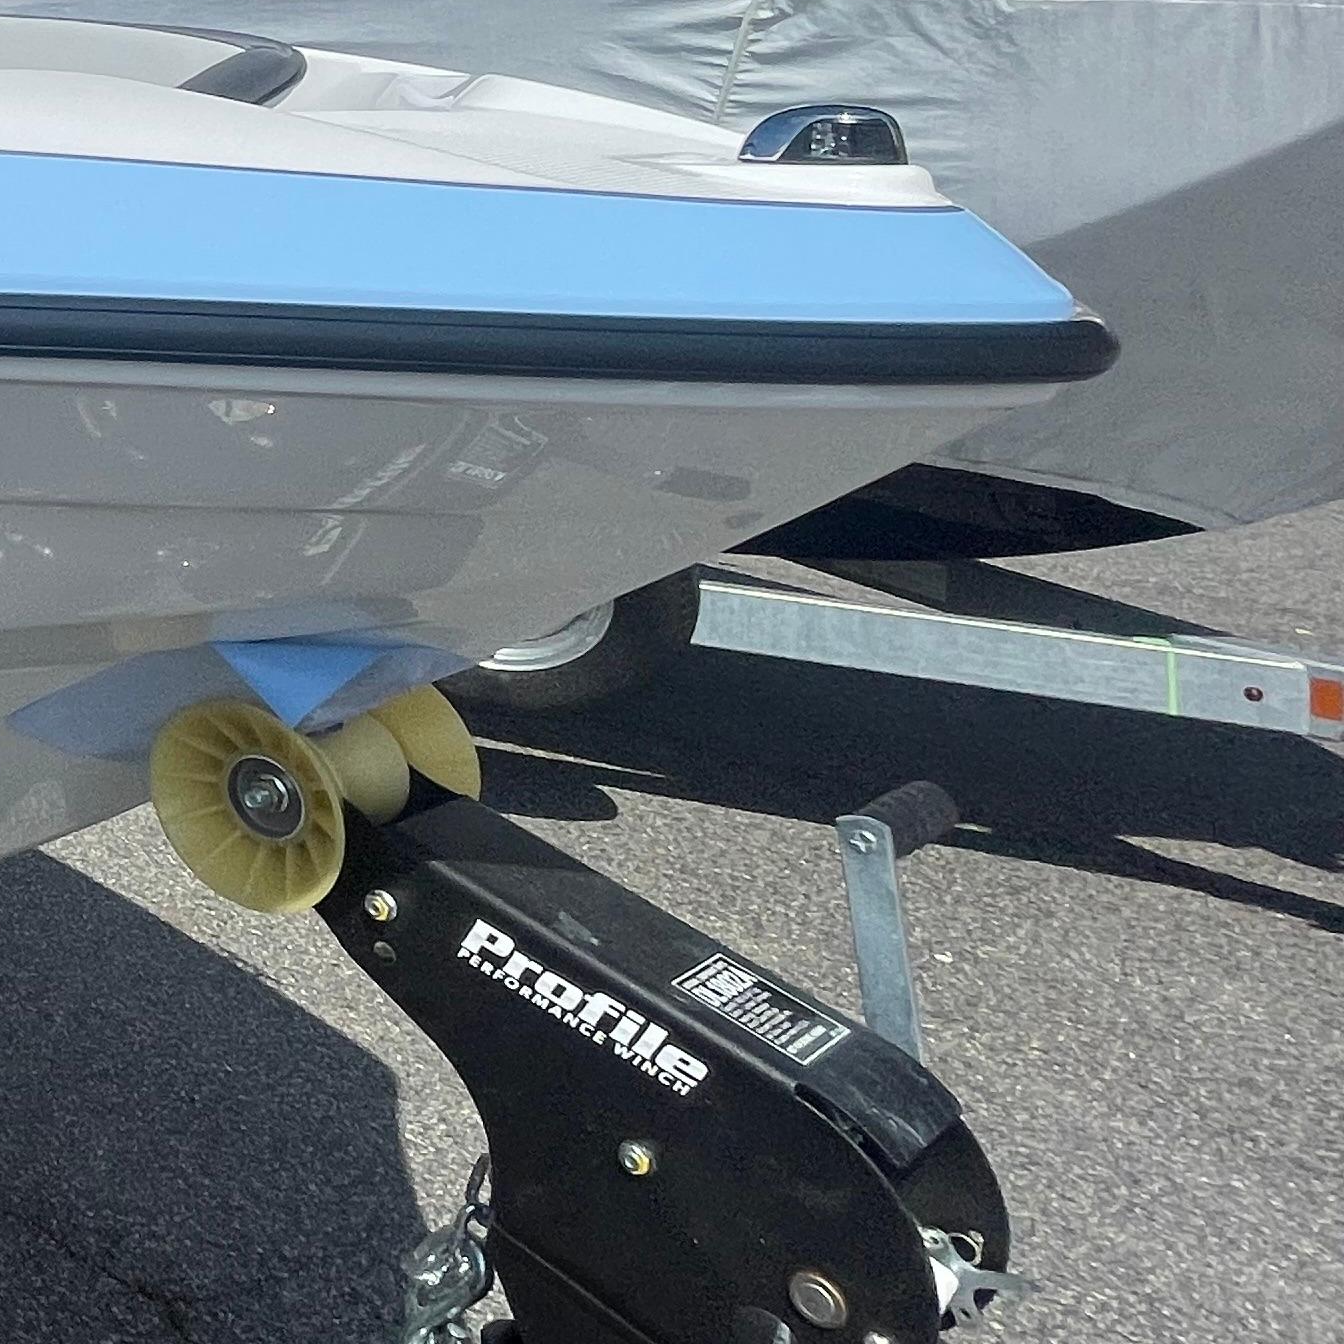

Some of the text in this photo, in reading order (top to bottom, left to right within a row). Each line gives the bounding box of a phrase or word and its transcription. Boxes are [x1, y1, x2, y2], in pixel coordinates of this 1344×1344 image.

[456, 947, 607, 1046] PERFORMANCE
[613, 1042, 692, 1097] WINCH
[460, 918, 709, 1088] Profile
